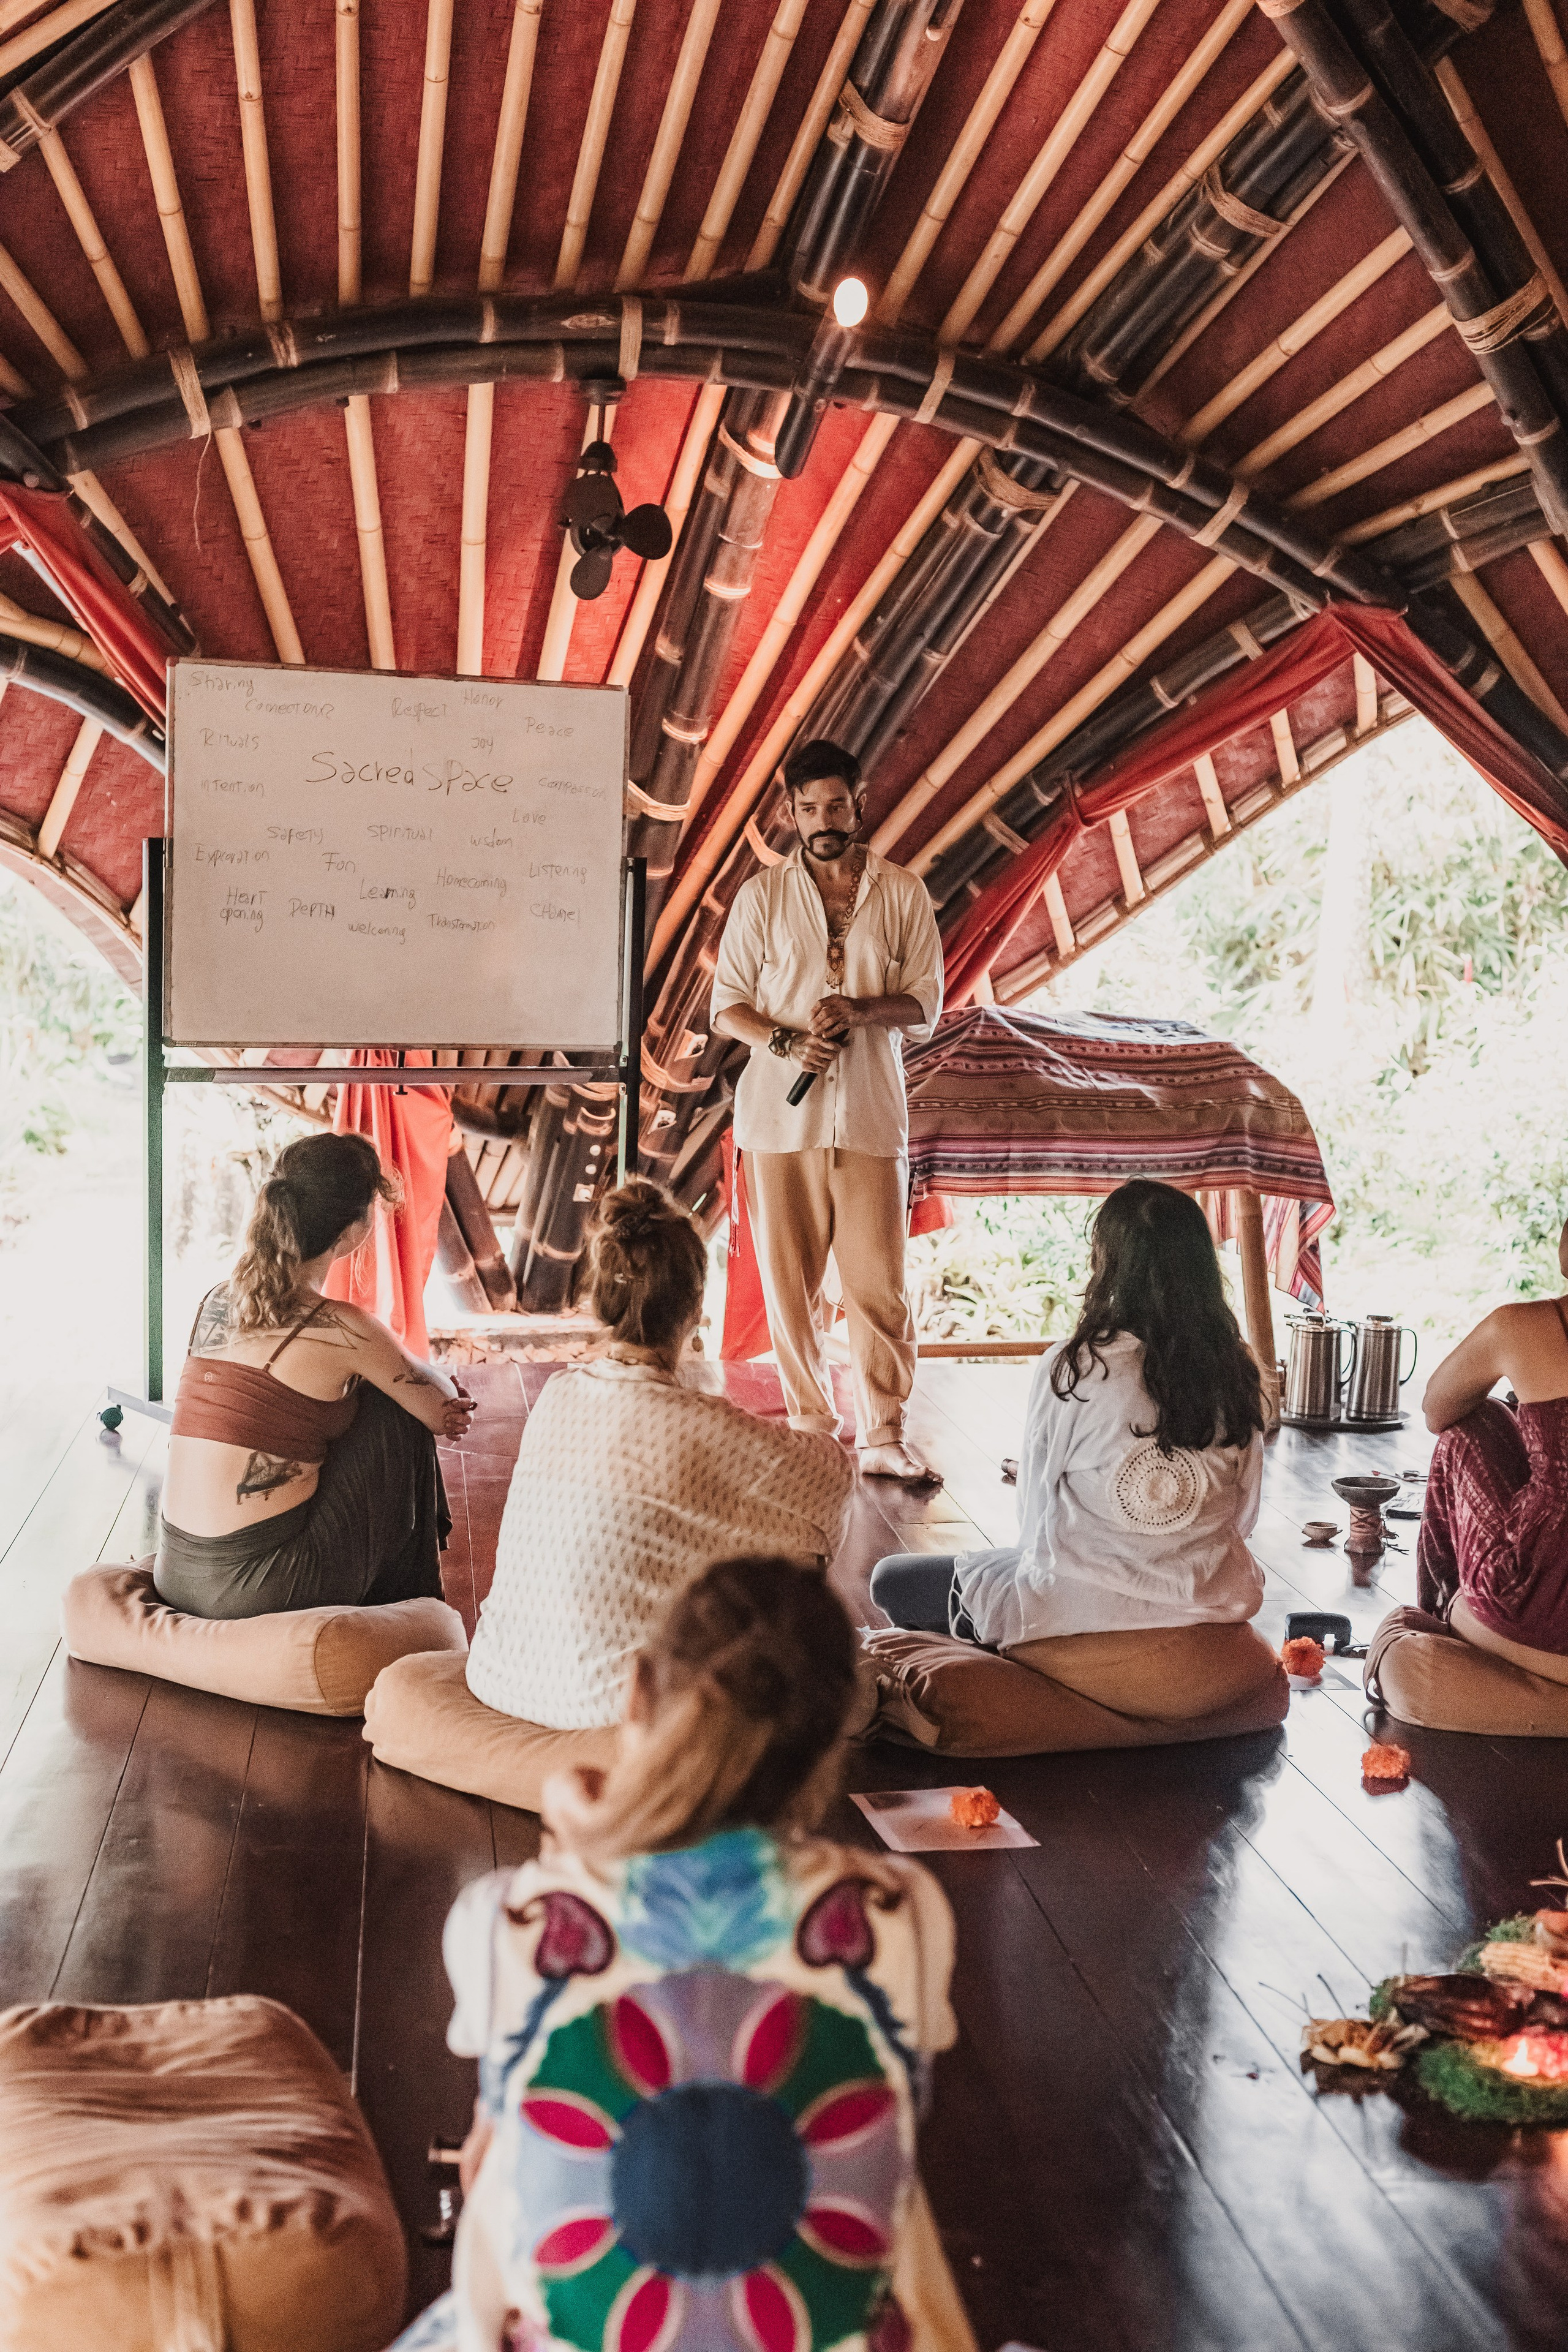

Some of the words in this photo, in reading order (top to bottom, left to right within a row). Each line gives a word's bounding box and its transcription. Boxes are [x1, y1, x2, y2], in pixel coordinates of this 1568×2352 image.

[524, 716, 575, 737] Peace
[306, 748, 413, 784] Sacred
[512, 807, 546, 825] Love
